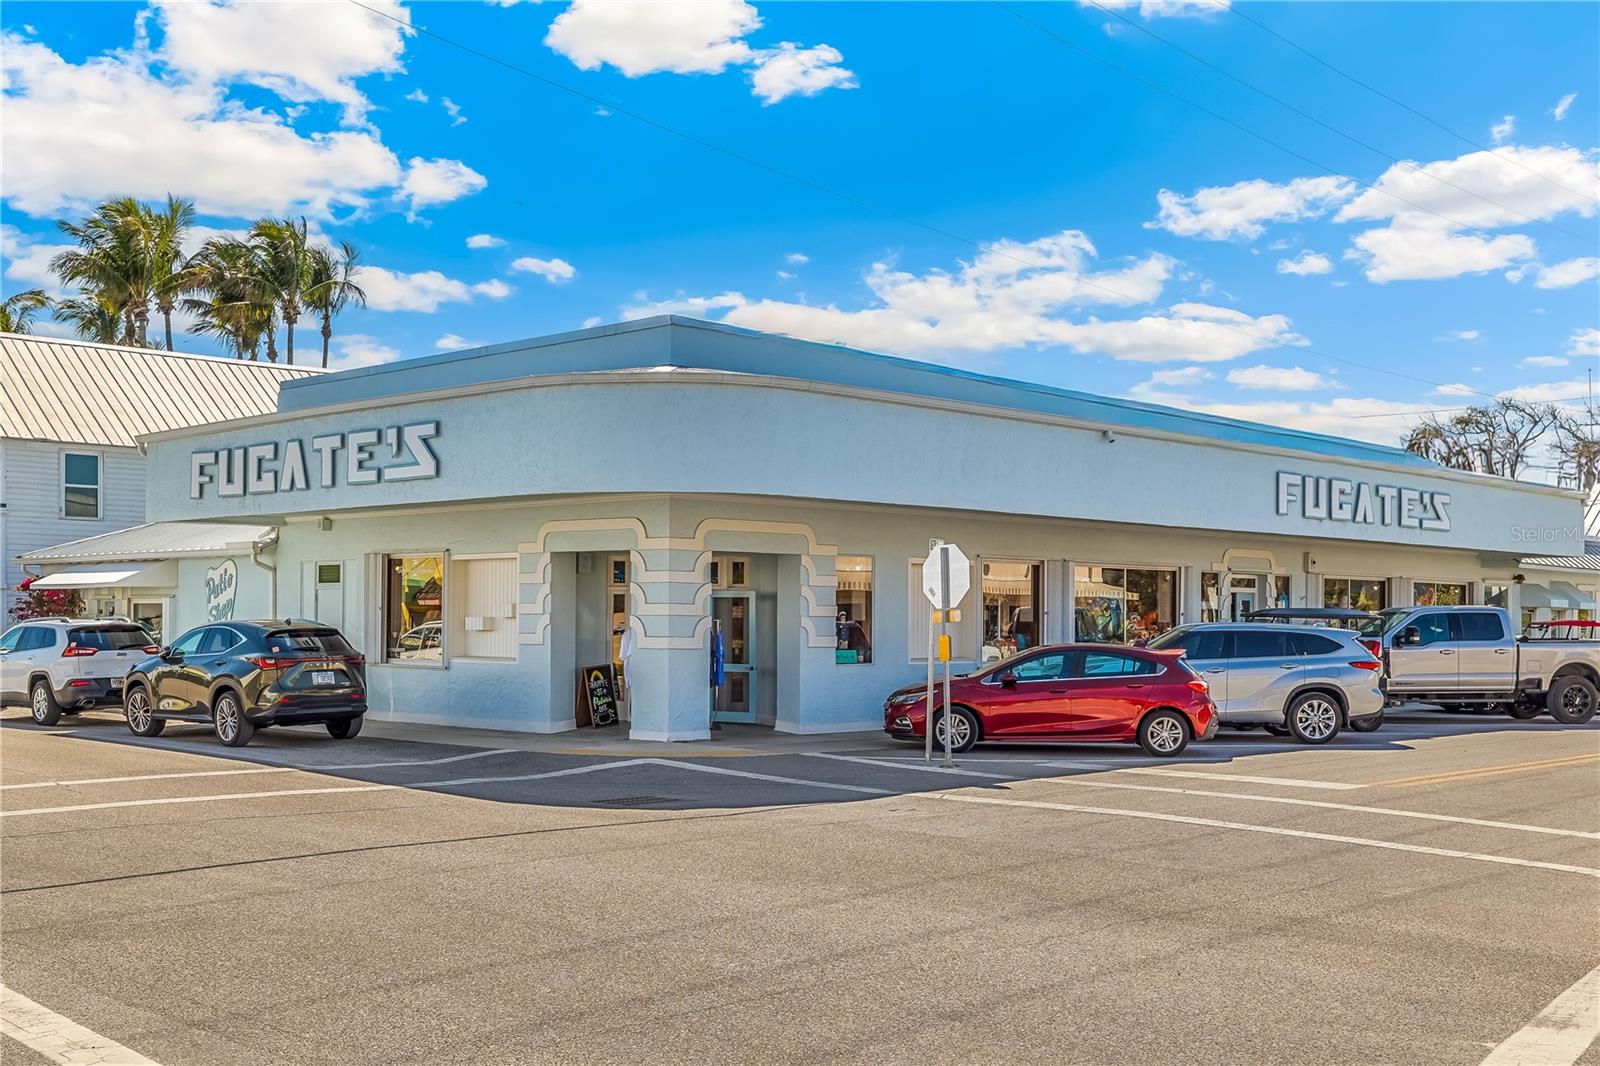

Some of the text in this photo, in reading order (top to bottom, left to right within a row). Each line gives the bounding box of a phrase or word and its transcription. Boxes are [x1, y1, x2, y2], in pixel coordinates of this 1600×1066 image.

[190, 420, 438, 500] FUGATE'S
[1276, 471, 1452, 532] FUGATE'S
[206, 568, 233, 604] Patio
[209, 598, 233, 621] Shop
